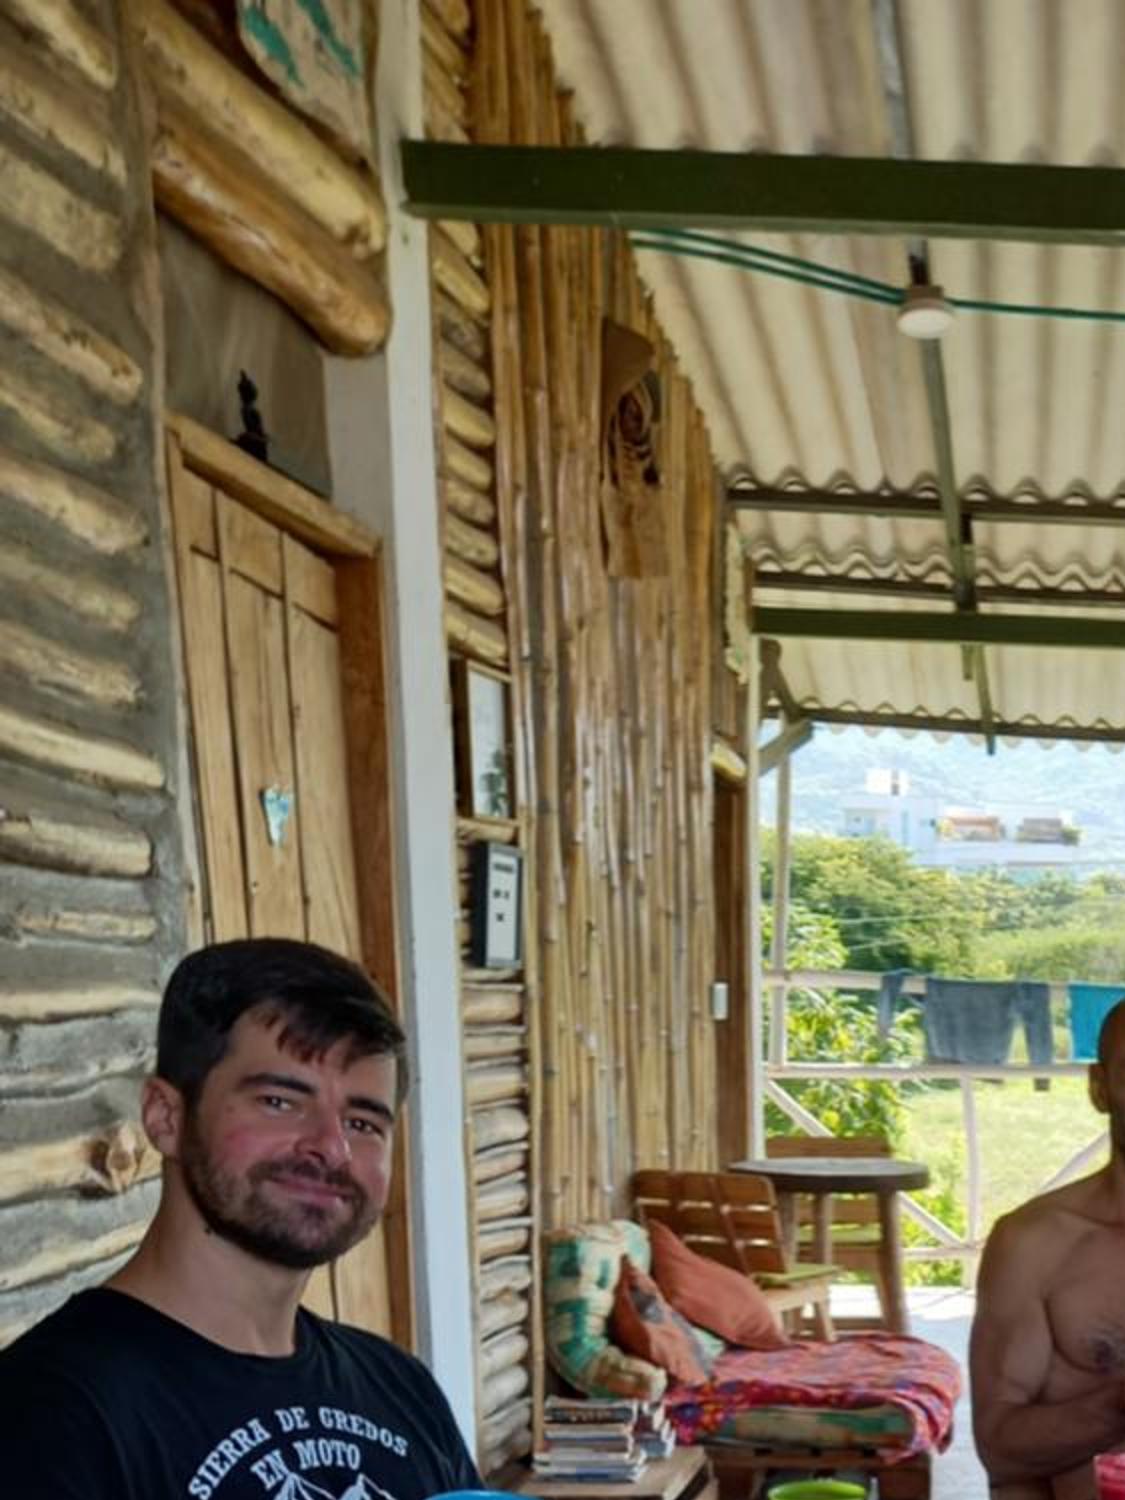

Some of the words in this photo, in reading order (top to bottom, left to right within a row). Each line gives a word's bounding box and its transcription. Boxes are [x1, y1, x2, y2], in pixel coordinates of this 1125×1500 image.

[275, 1407, 310, 1432] DE
[318, 1407, 408, 1457] GREDOS
[250, 1449, 290, 1491] EN
[293, 1438, 361, 1471] MOTO
